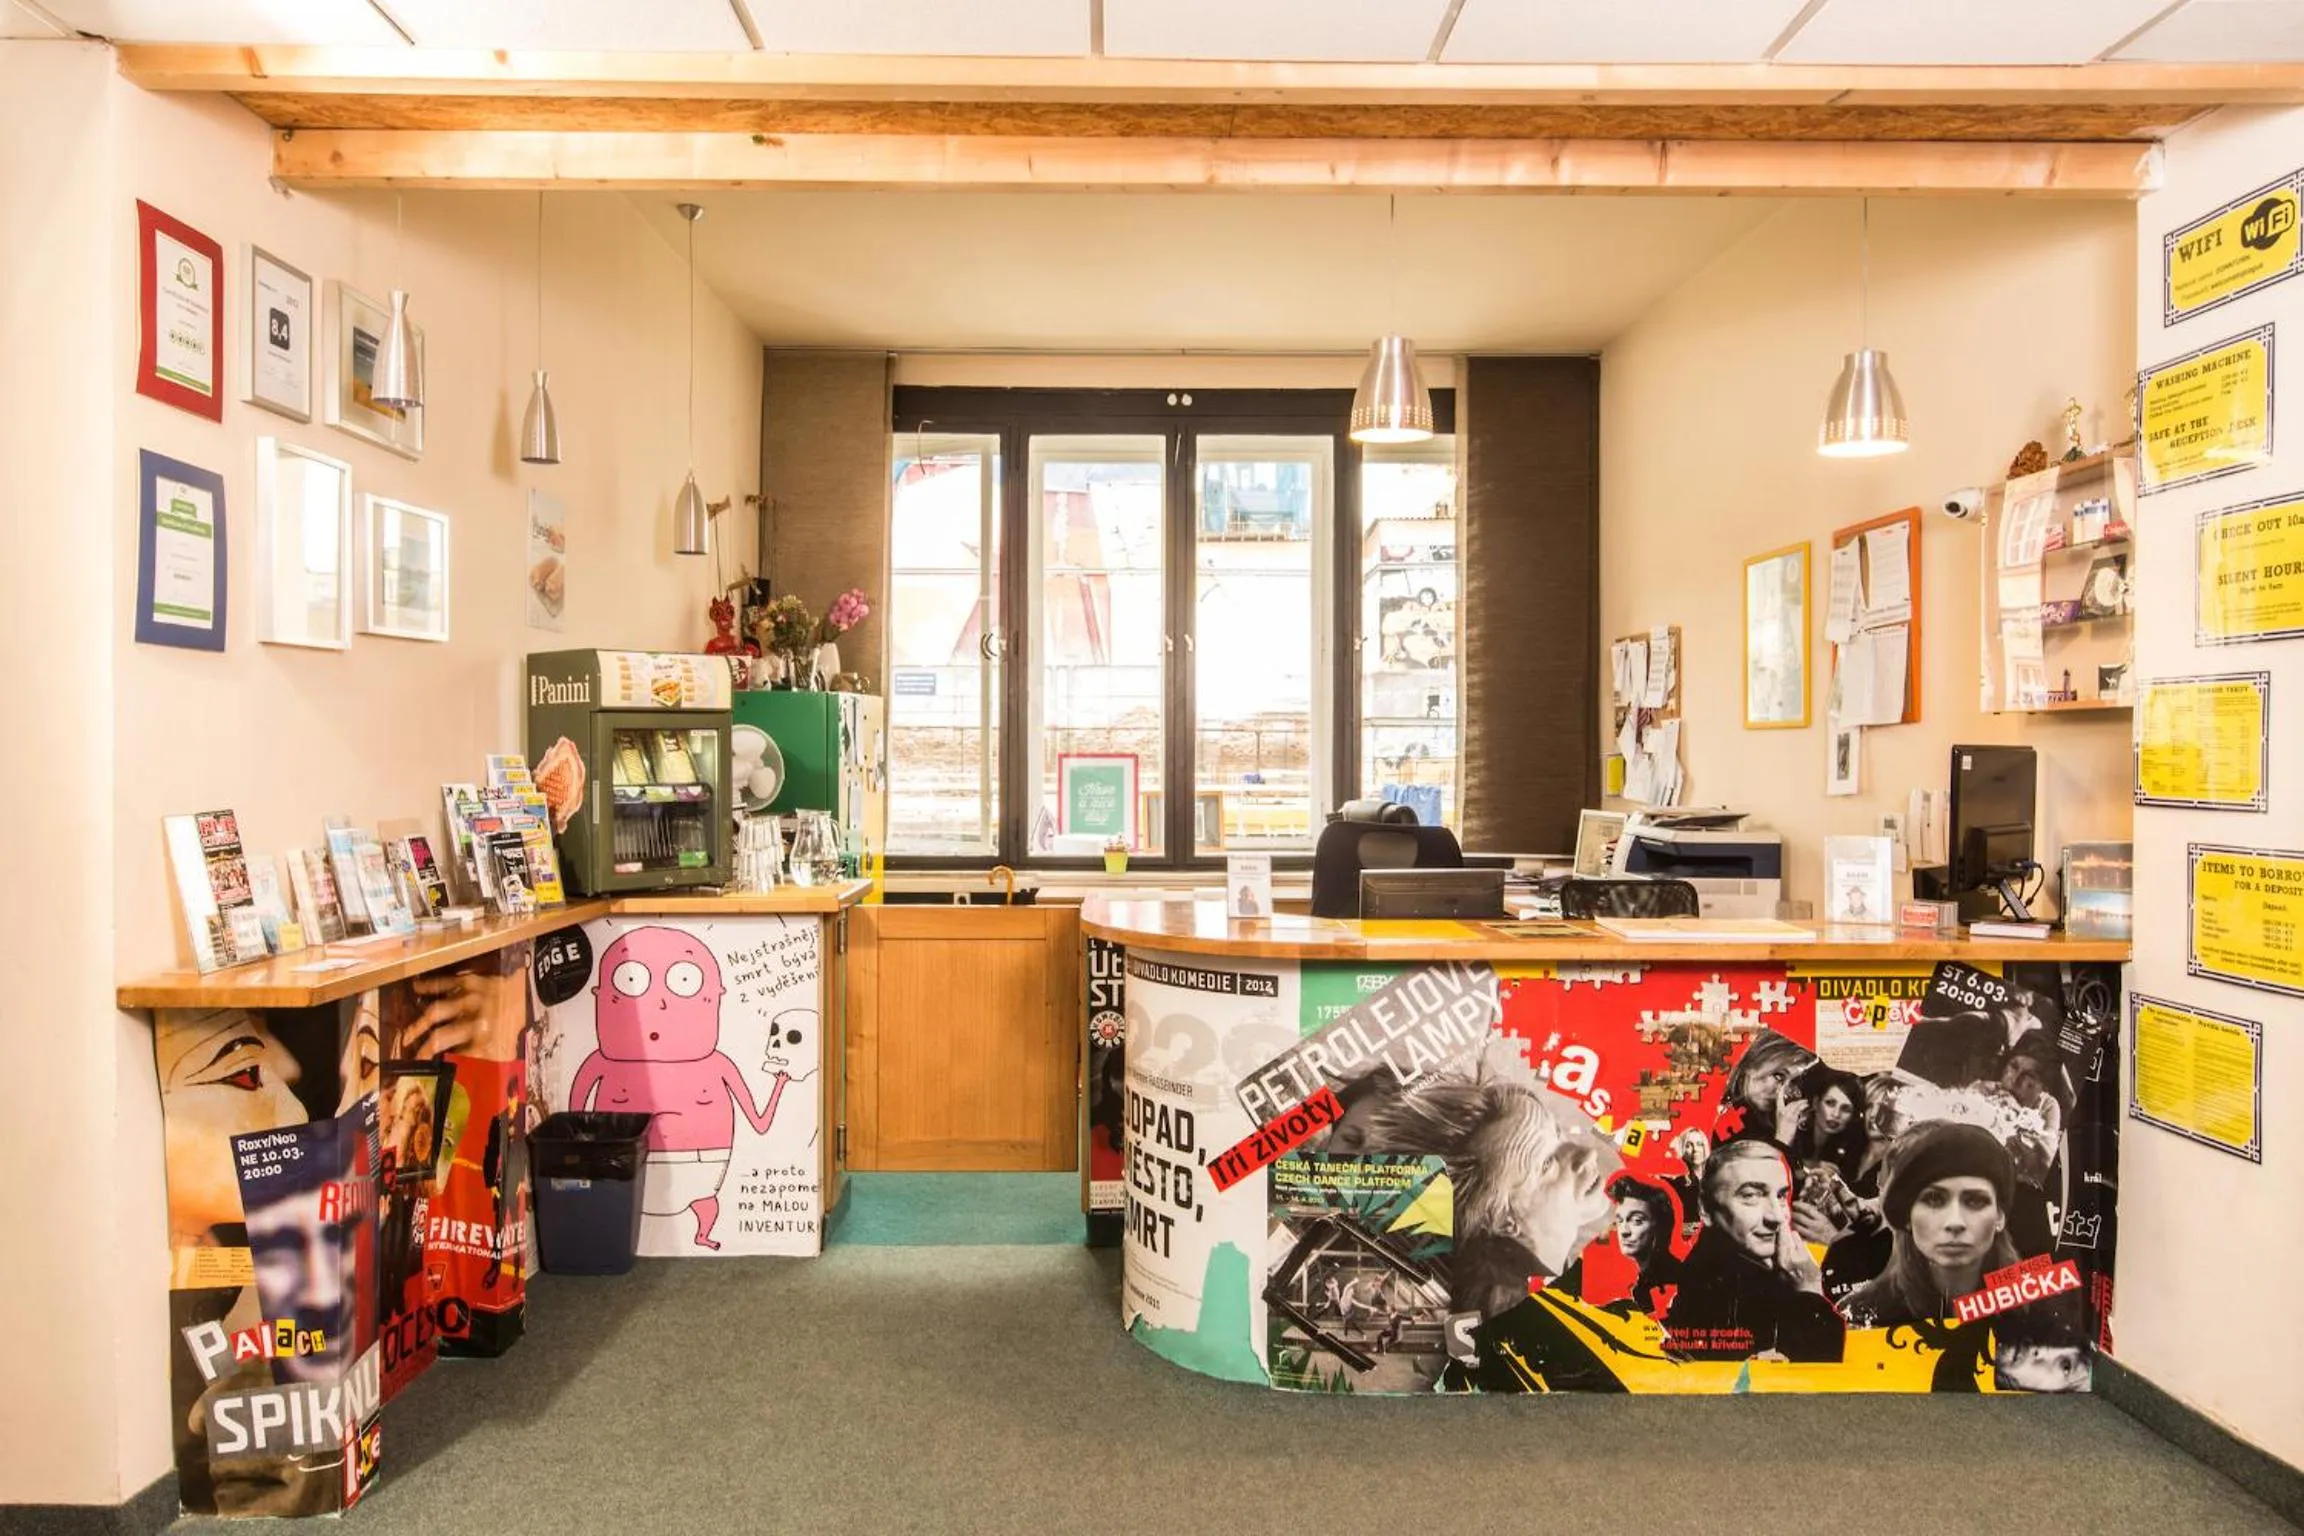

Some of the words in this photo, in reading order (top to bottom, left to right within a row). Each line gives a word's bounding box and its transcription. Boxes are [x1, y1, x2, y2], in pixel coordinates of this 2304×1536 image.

[2178, 227, 2222, 263] WIFI
[2156, 367, 2199, 390] WASHING
[2202, 349, 2252, 375] MACHINE
[2174, 421, 2187, 435] AT
[2190, 415, 2210, 431] THE
[2257, 517, 2283, 532] OUT
[2263, 561, 2304, 579] HOUR
[538, 674, 591, 705] Panini
[2202, 861, 2236, 875] ITEMS
[2239, 865, 2254, 877] TO
[2234, 880, 2252, 891] FOR
[2265, 884, 2304, 897] DEPOSIT
[538, 942, 581, 981] EDGE
[734, 961, 772, 985] smrt
[1171, 968, 1232, 992] KOMEDIE
[1819, 979, 1902, 997] DIVADLO
[1942, 964, 1965, 982] ST
[1966, 972, 2009, 1003] 6.03.
[1935, 980, 1987, 1010] 20:00
[1381, 976, 1501, 1087] LAMPY
[240, 1153, 259, 1167] NE
[262, 1147, 305, 1163] 10.03.
[243, 1164, 283, 1181] 20:00
[764, 1163, 806, 1180] proto
[1364, 1163, 1429, 1176] PLATFORMA
[1274, 1172, 1310, 1185] CZECH
[1313, 1175, 1351, 1187] DANCE
[1354, 1176, 1412, 1189] PLATFORM
[738, 1201, 755, 1211] na
[762, 1199, 809, 1213] MALOU
[1957, 1266, 2083, 1322] HUBIČKA
